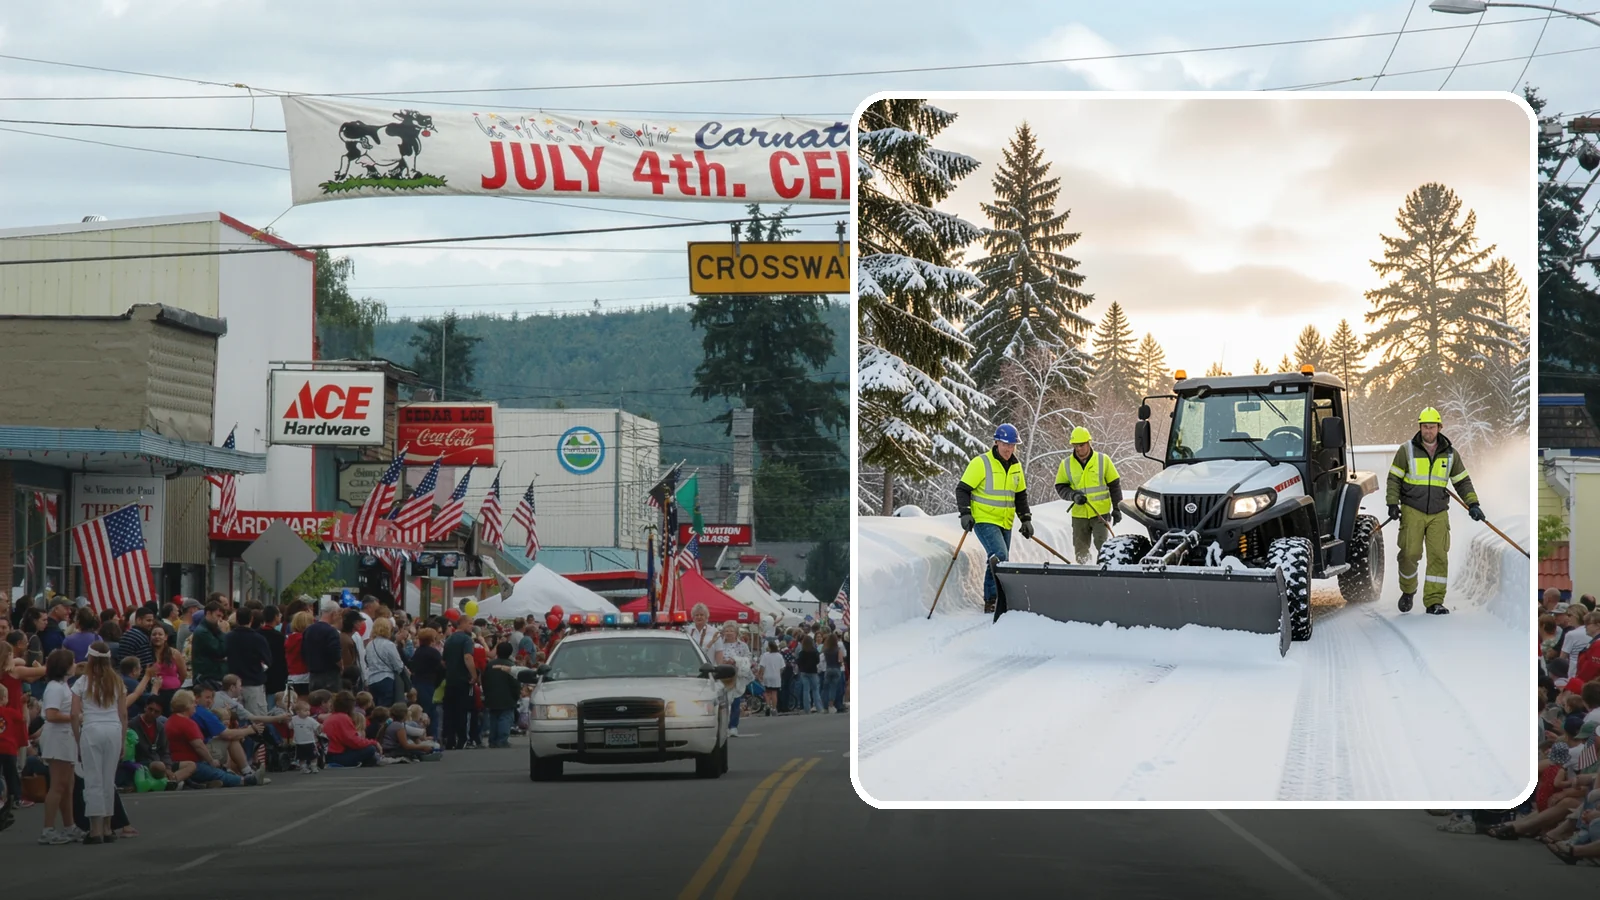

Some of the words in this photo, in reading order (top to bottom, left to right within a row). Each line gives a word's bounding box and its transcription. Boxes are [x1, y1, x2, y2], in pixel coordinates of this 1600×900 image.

[481, 141, 605, 193] JULY
[632, 150, 747, 198] 4th.
[697, 254, 850, 280] CROSSWA
[282, 380, 373, 419] ACE
[406, 409, 452, 422] CEDAR
[461, 409, 485, 421] LOG
[284, 421, 370, 436] Hardware
[416, 428, 477, 447] Coca-Cola
[353, 468, 384, 480] Simpl
[83, 484, 93, 494] St.
[96, 485, 124, 495] Vincent
[126, 486, 135, 495] de
[138, 486, 155, 495] Paul
[699, 535, 730, 543] GLASS
